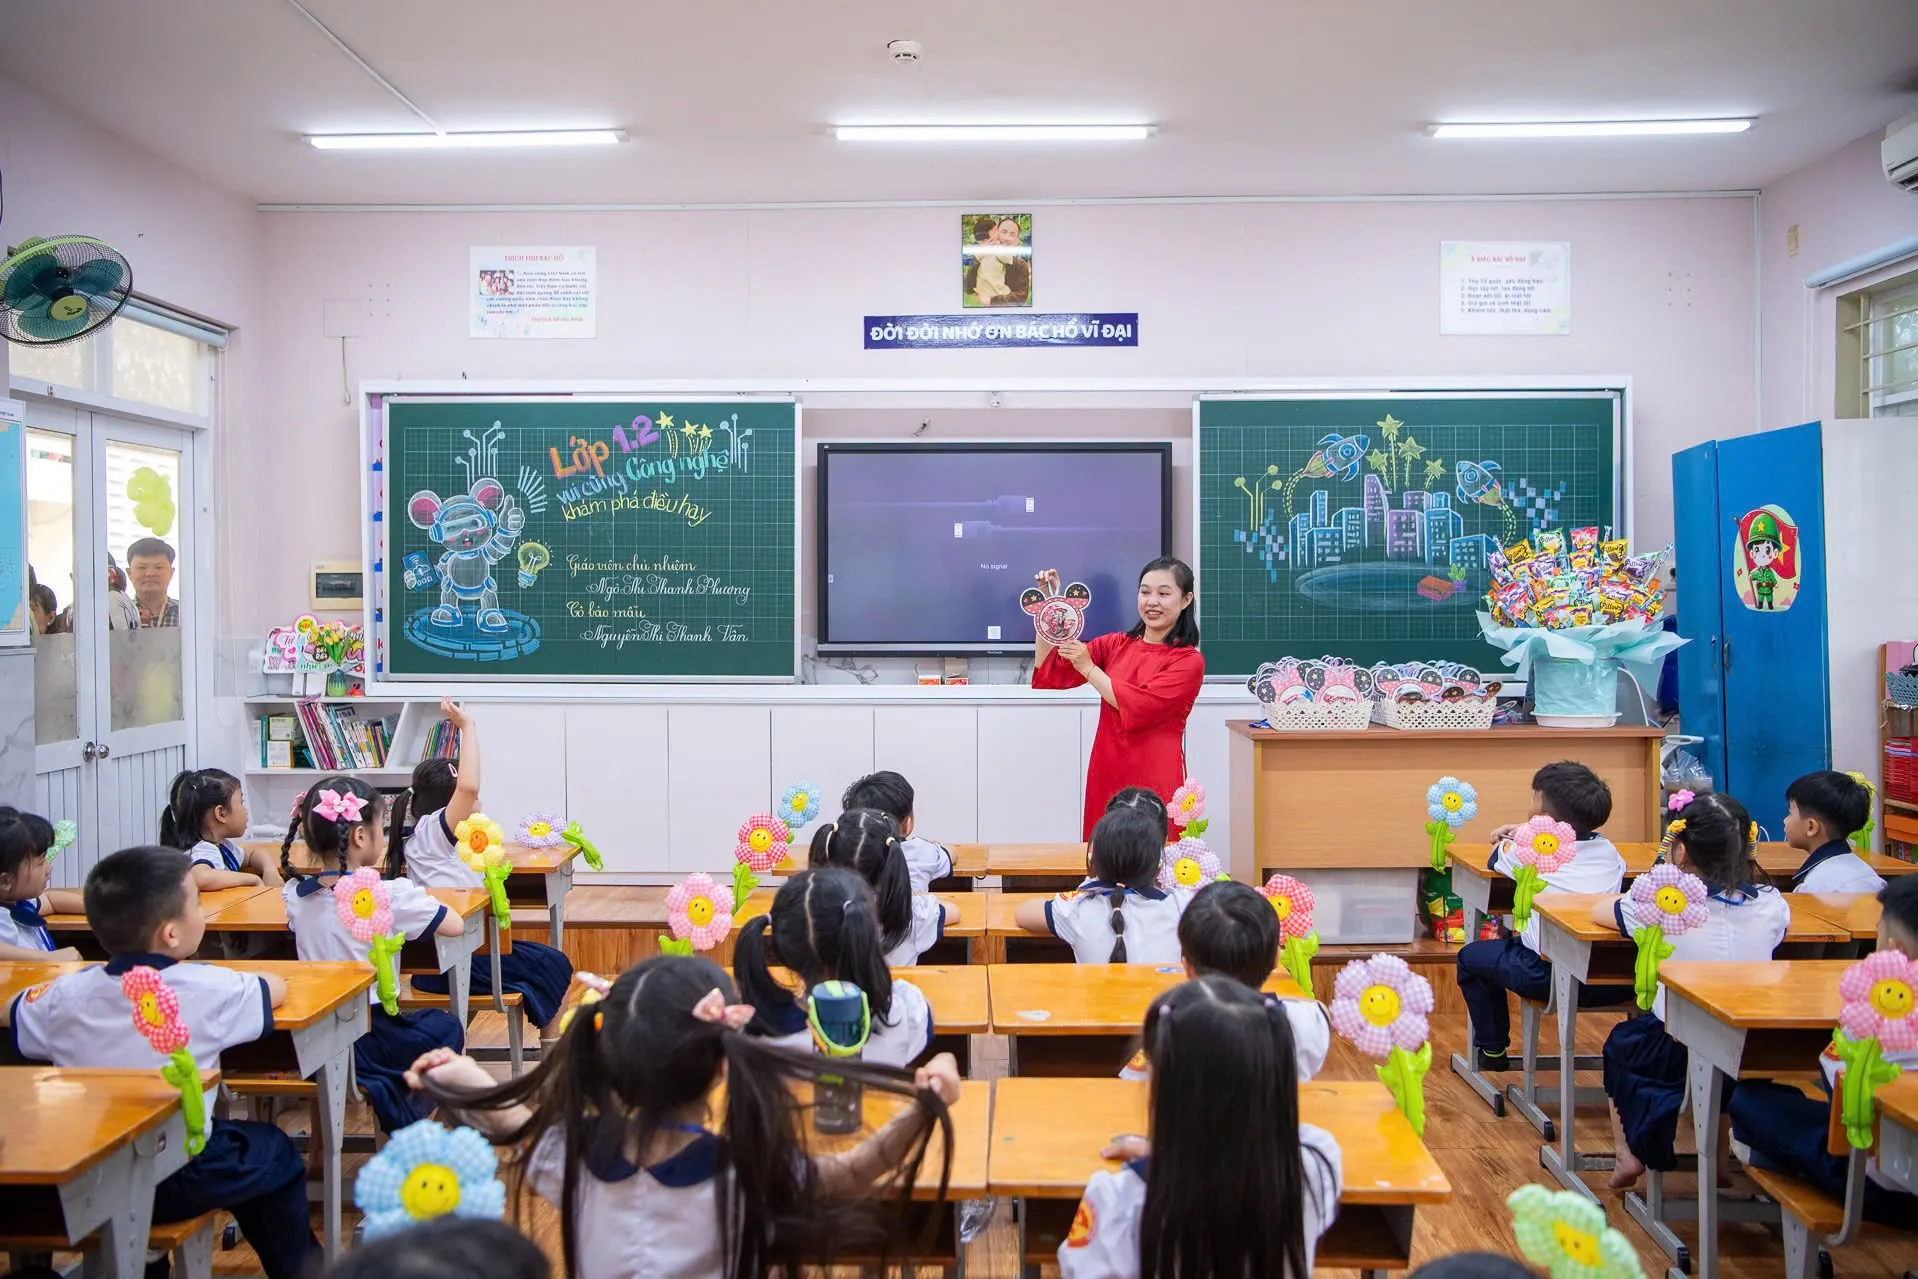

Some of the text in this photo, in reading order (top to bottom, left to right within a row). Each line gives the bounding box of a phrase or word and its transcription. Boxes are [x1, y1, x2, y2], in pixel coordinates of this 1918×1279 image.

[870, 317, 1132, 342] ĐỜI ĐỜI NHỚ ƠN BÁC HỒ VĨ ĐẠI
[549, 415, 660, 480] Lớp 1.2
[556, 483, 581, 505] vui
[625, 455, 676, 484] Công
[680, 445, 729, 480] nghệ
[561, 489, 712, 527] khám phá điều hay
[566, 553, 697, 578] Giáo viên chủ nhiệm
[990, 562, 1008, 571] signal
[585, 575, 620, 602] Ngô
[646, 573, 695, 595] Thanh
[696, 574, 751, 606] Phương
[566, 600, 646, 618] Cô bảo mẫu
[579, 619, 748, 650] Nguyễn Thị Thanh Vân
